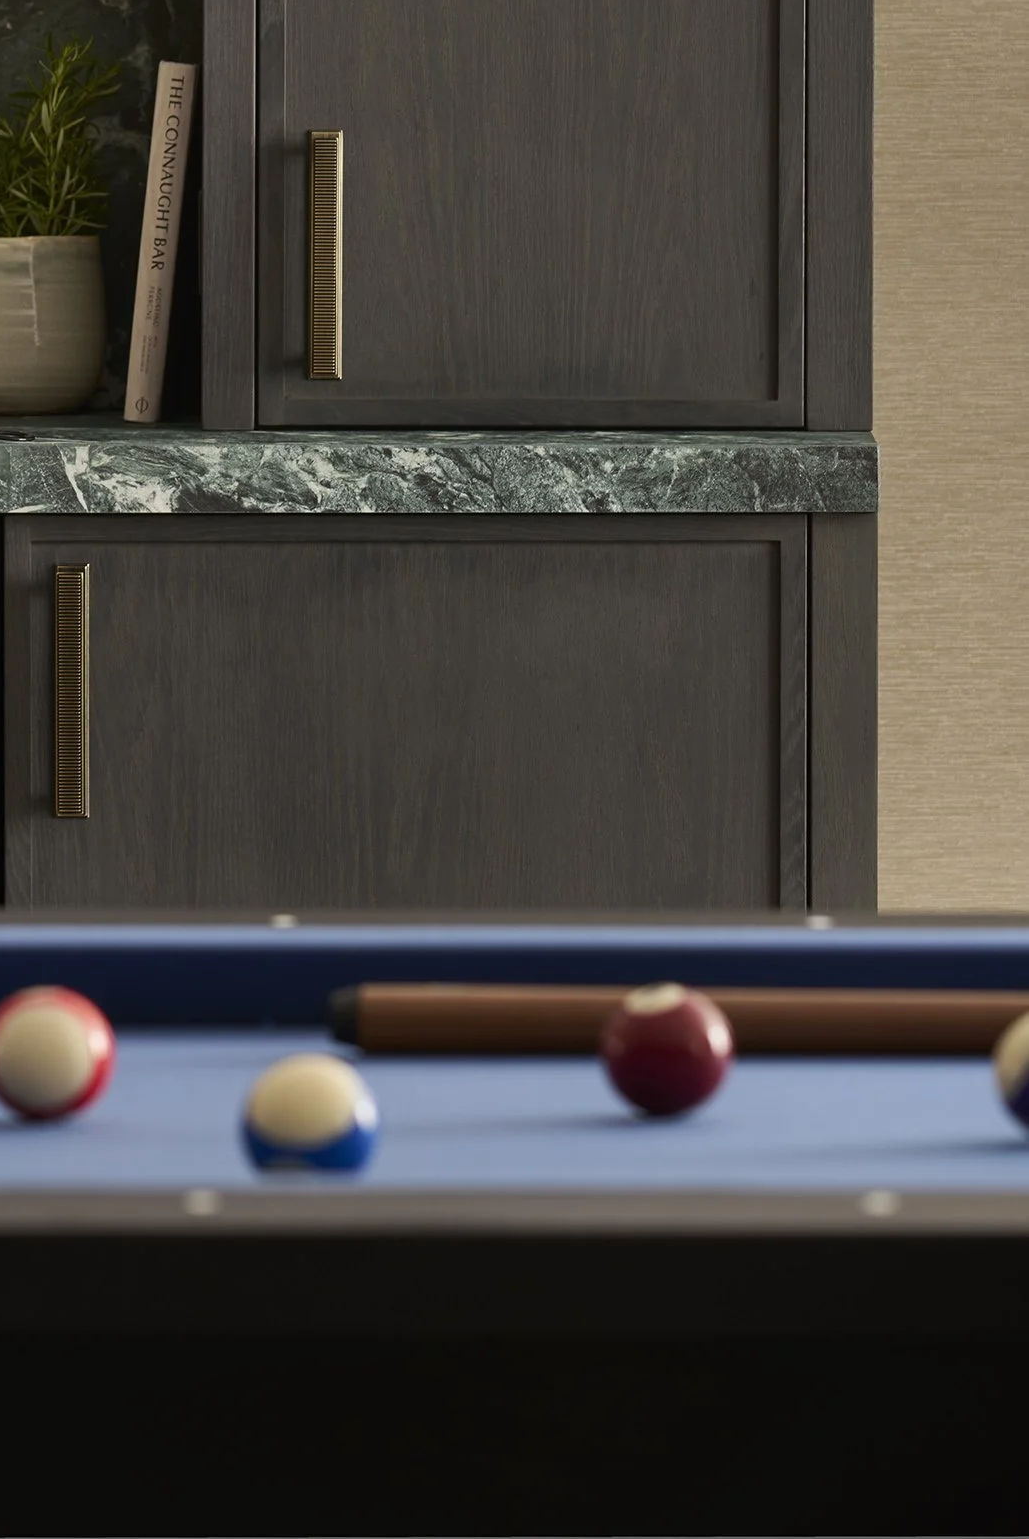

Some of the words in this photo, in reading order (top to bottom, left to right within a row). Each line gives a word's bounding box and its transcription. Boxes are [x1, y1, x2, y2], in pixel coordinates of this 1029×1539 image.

[169, 75, 185, 109] THE
[154, 113, 181, 231] CONNAUGHT
[151, 237, 167, 271] BAR
